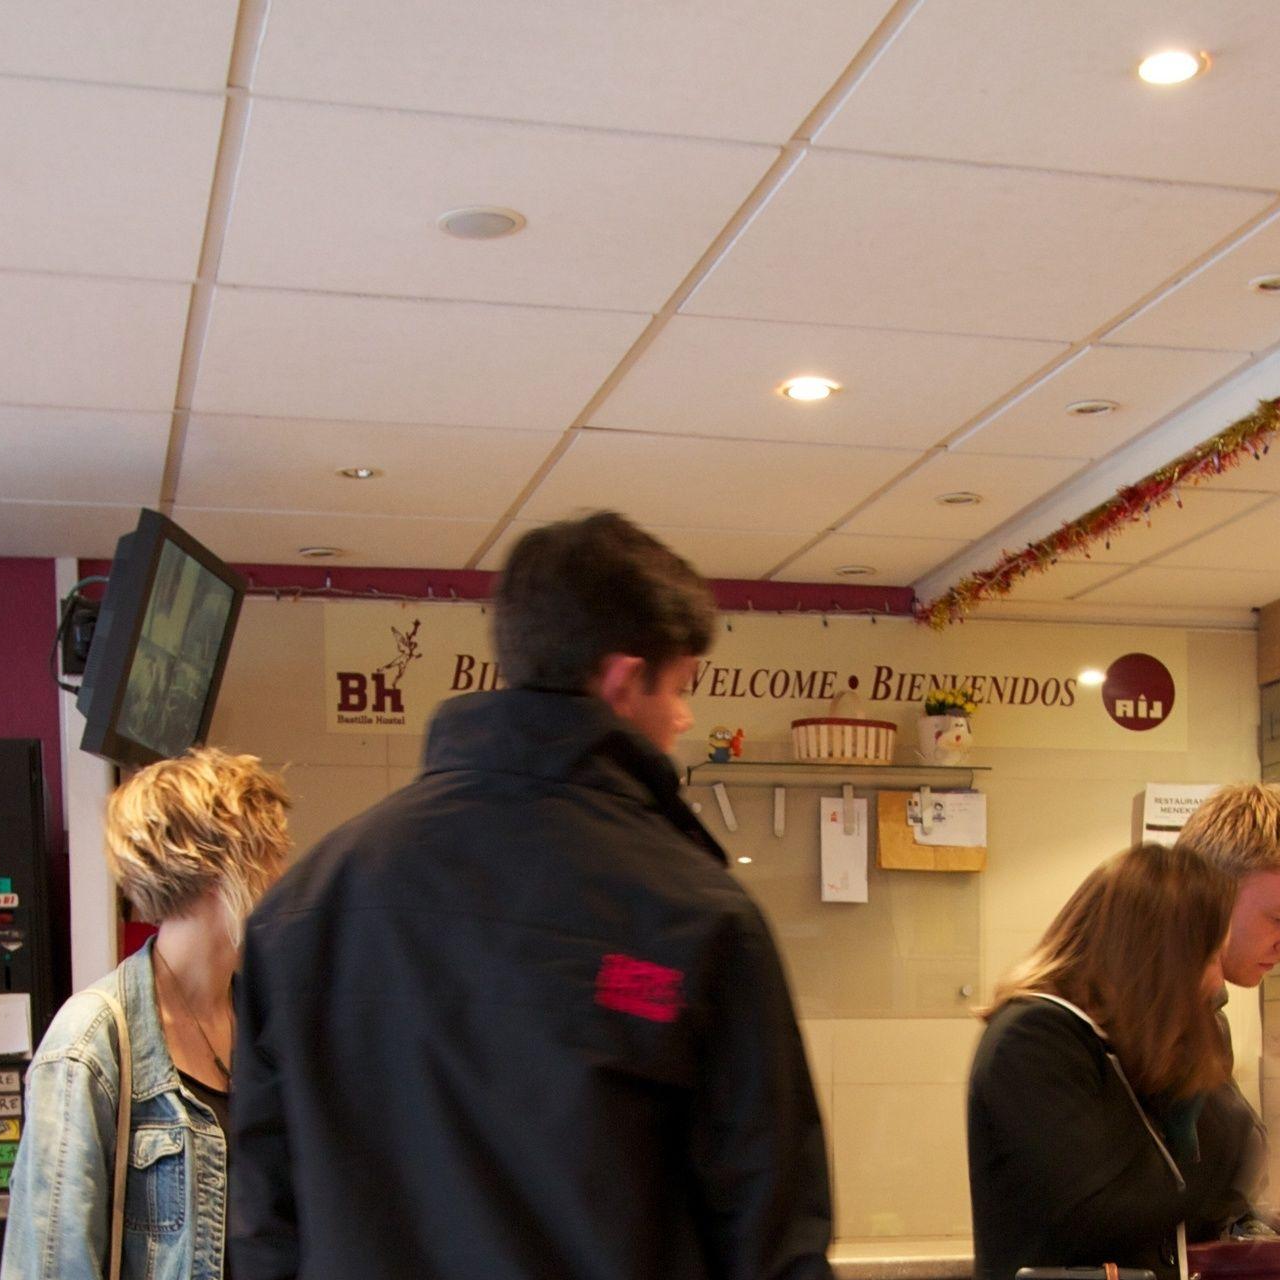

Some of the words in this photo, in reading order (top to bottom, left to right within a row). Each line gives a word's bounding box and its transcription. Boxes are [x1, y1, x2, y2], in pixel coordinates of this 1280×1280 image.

[337, 672, 404, 712] Bh
[337, 714, 373, 724] Bastille
[375, 715, 405, 724] Hostel
